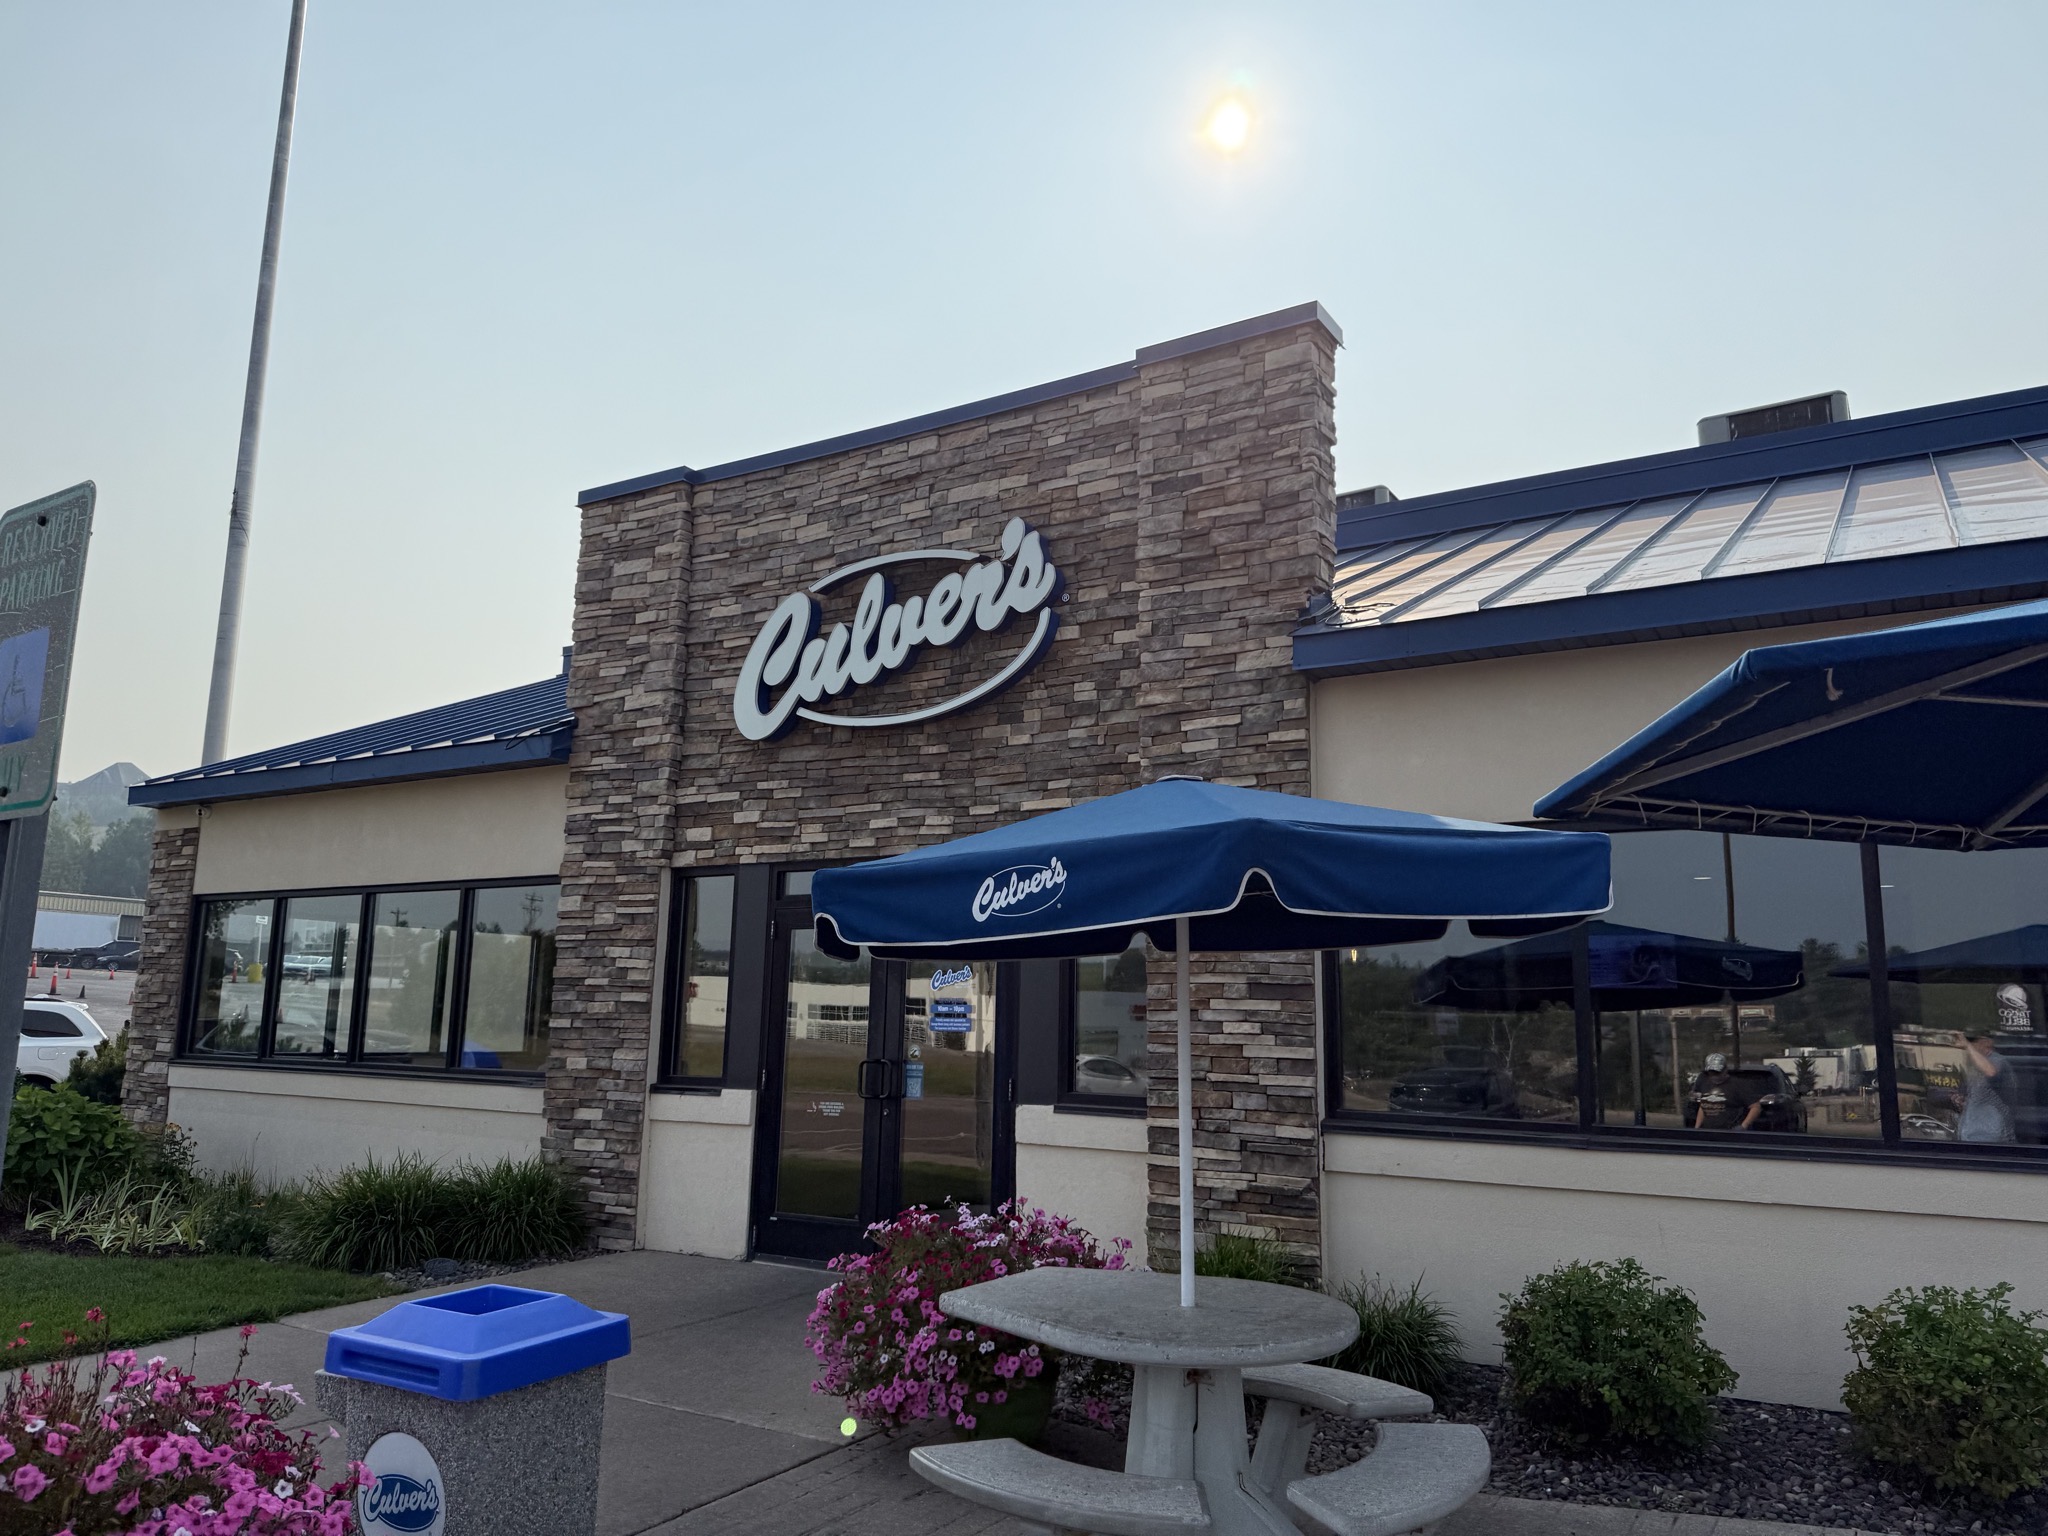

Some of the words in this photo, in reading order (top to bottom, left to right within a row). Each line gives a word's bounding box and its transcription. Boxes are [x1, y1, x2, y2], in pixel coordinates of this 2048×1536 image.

[2, 507, 80, 567] RESERVED
[0, 558, 66, 611] PARKING
[733, 516, 1057, 741] Culver's
[971, 856, 1068, 923] Culver's
[931, 965, 973, 991] Culver's
[364, 1479, 439, 1522] Culver's
